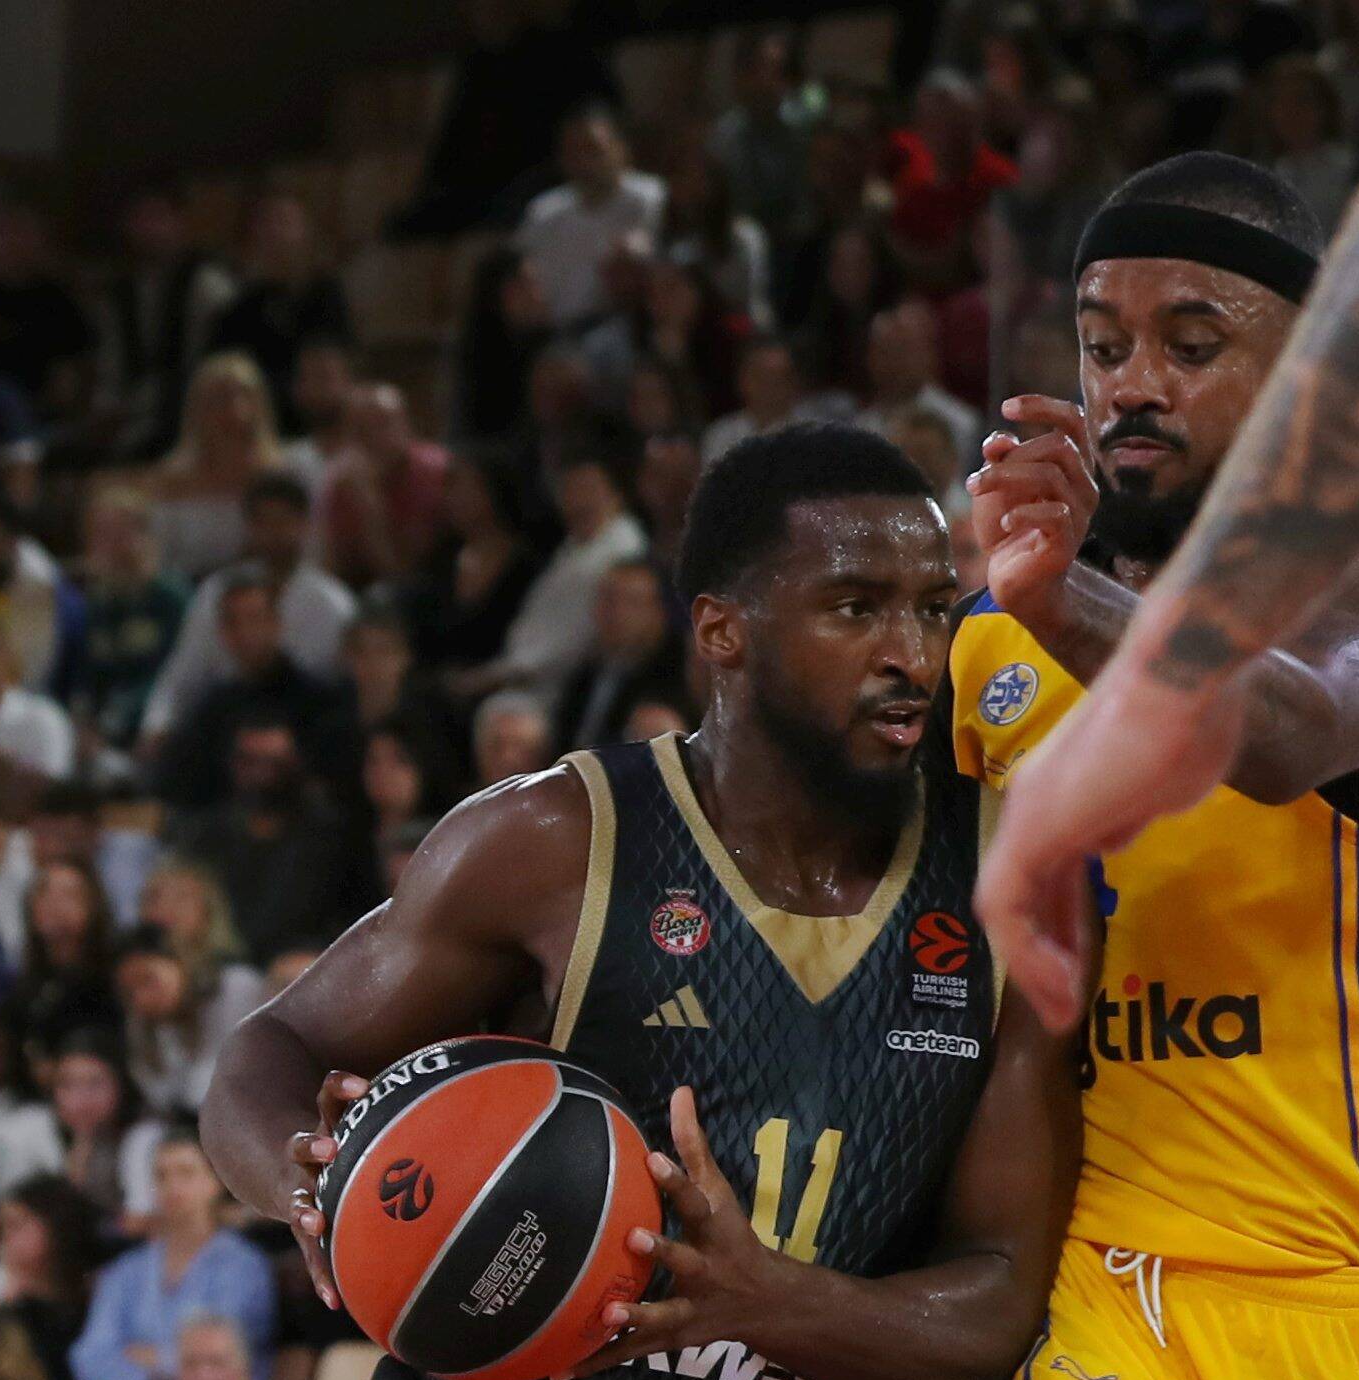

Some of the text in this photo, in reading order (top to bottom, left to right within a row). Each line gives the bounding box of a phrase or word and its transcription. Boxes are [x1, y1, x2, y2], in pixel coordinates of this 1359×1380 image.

[912, 973, 968, 987] TURKISH
[912, 984, 968, 998] AIRLINES
[887, 1030, 979, 1058] oneteam
[1084, 974, 1263, 1072] tika
[751, 1117, 843, 1264] 11
[459, 1209, 539, 1317] LEGACY
